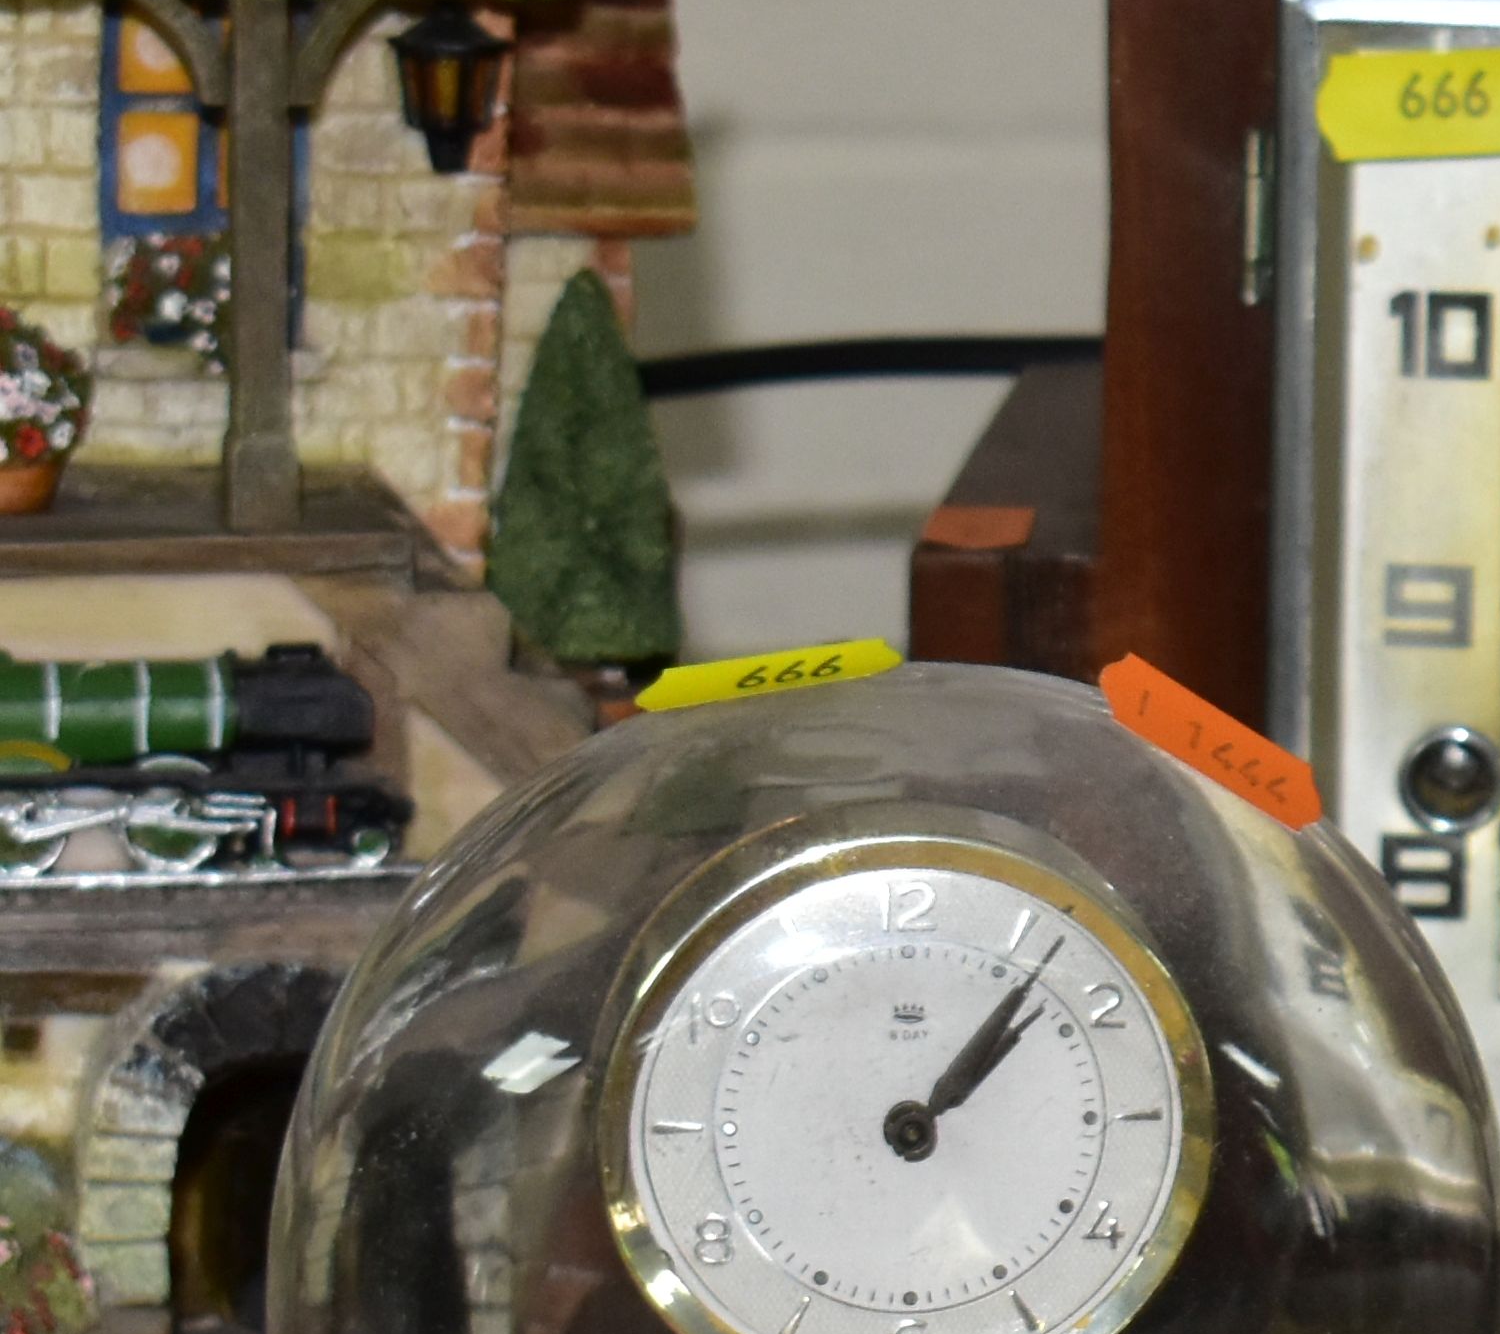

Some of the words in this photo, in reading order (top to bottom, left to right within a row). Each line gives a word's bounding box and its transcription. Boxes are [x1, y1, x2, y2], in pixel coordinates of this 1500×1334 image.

[1400, 71, 1491, 119] 666
[1388, 290, 1493, 381] 10
[1384, 564, 1473, 648] 9
[736, 653, 843, 689] 666
[1380, 833, 1467, 920] 8
[876, 880, 938, 932] 12
[688, 991, 741, 1045] 10
[1084, 982, 1128, 1030] 2
[902, 1029, 928, 1041] DAY
[694, 1213, 733, 1265] 8
[1082, 1200, 1126, 1250] 4
